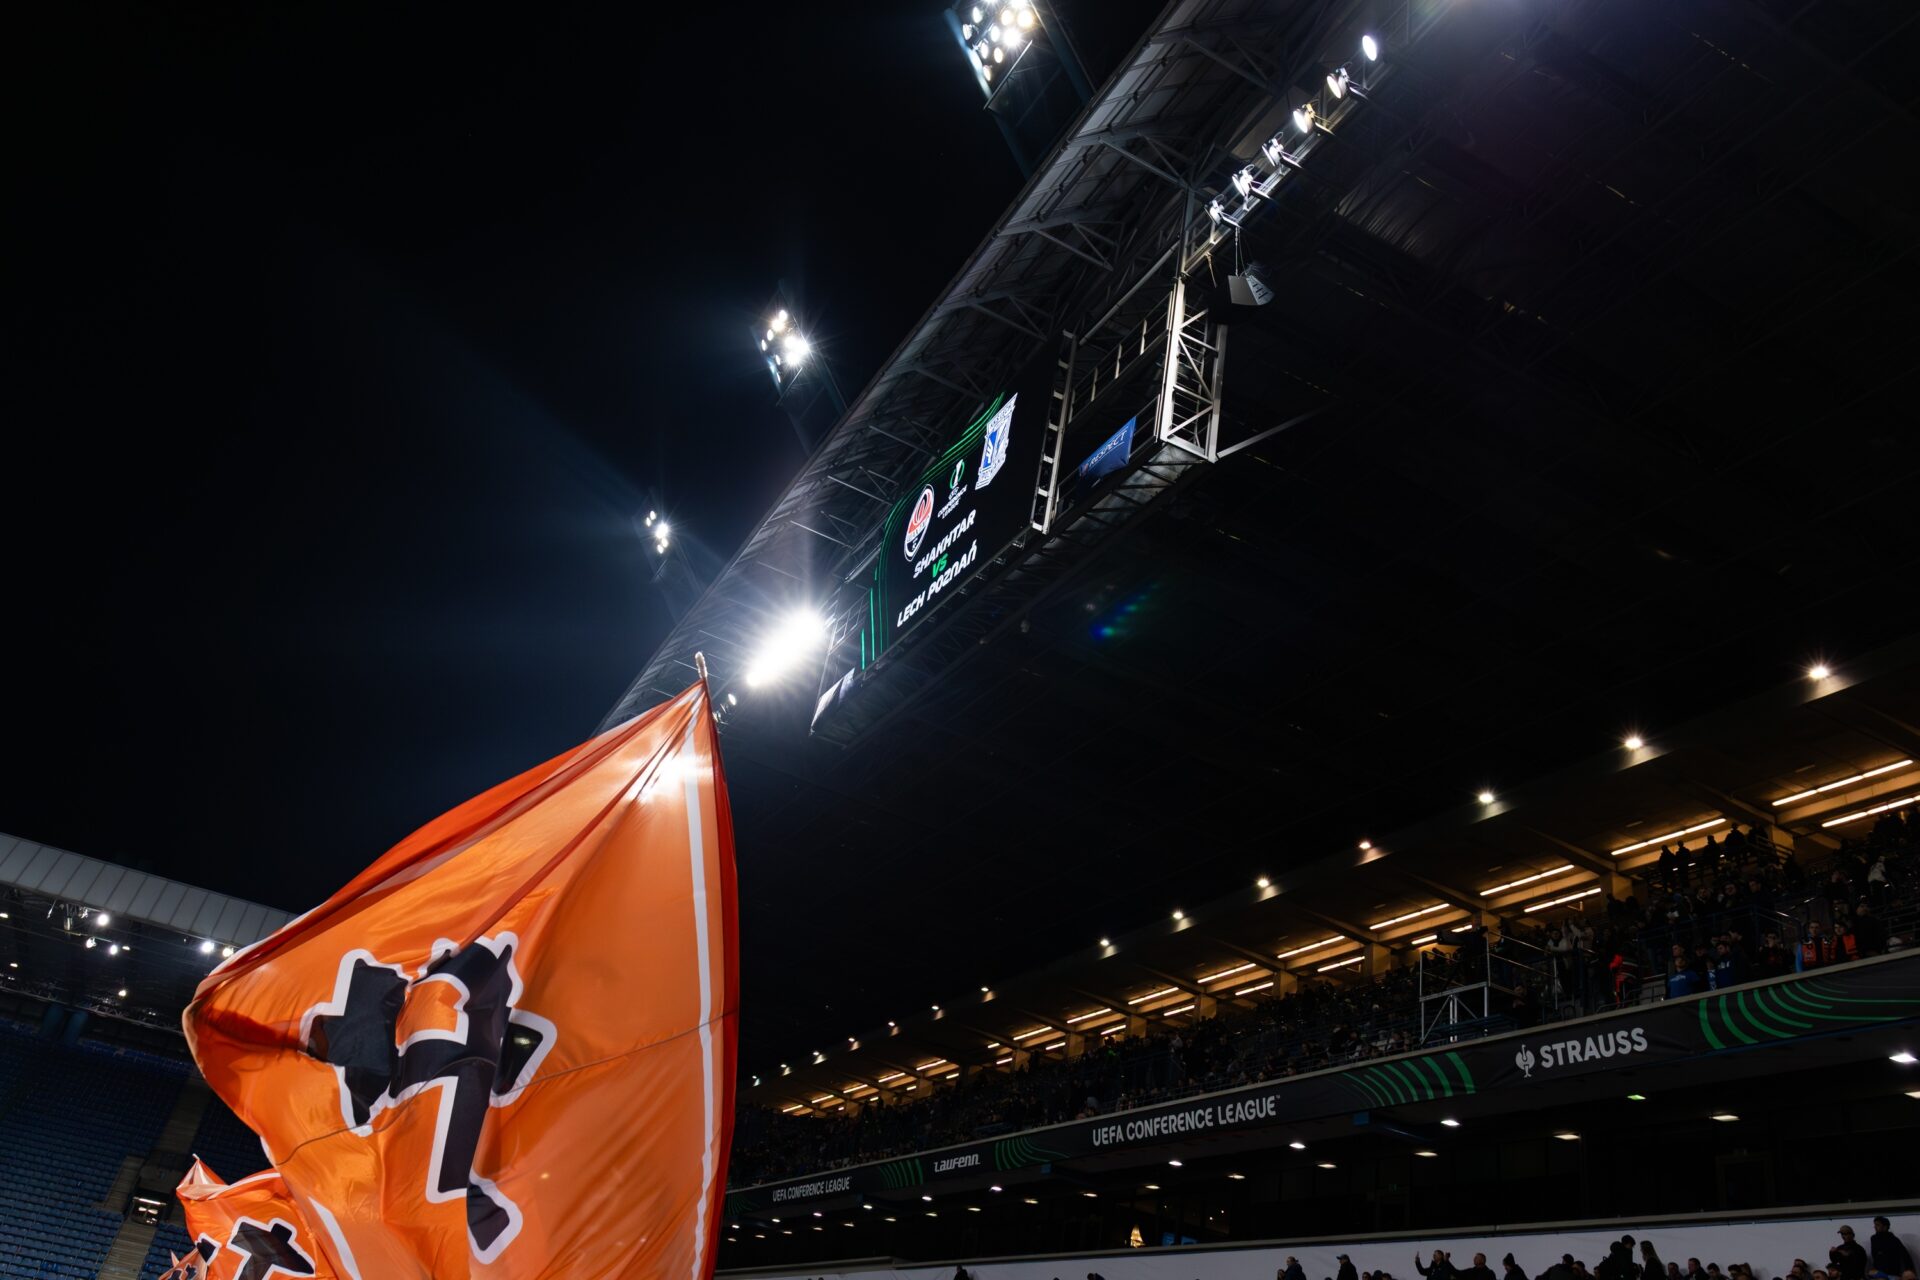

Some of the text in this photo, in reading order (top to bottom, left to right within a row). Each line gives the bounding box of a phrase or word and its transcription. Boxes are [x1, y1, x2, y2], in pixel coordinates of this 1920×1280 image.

[913, 509, 976, 578] SHAKHTAR
[932, 553, 948, 577] VS
[897, 590, 926, 628] LECH
[1539, 1027, 1648, 1068] STRAUSS
[1092, 1125, 1124, 1146] UEFA
[1126, 1108, 1213, 1140] CONFERENCE
[772, 1176, 850, 1202] UEFA CONFERENCE LEAGUE
